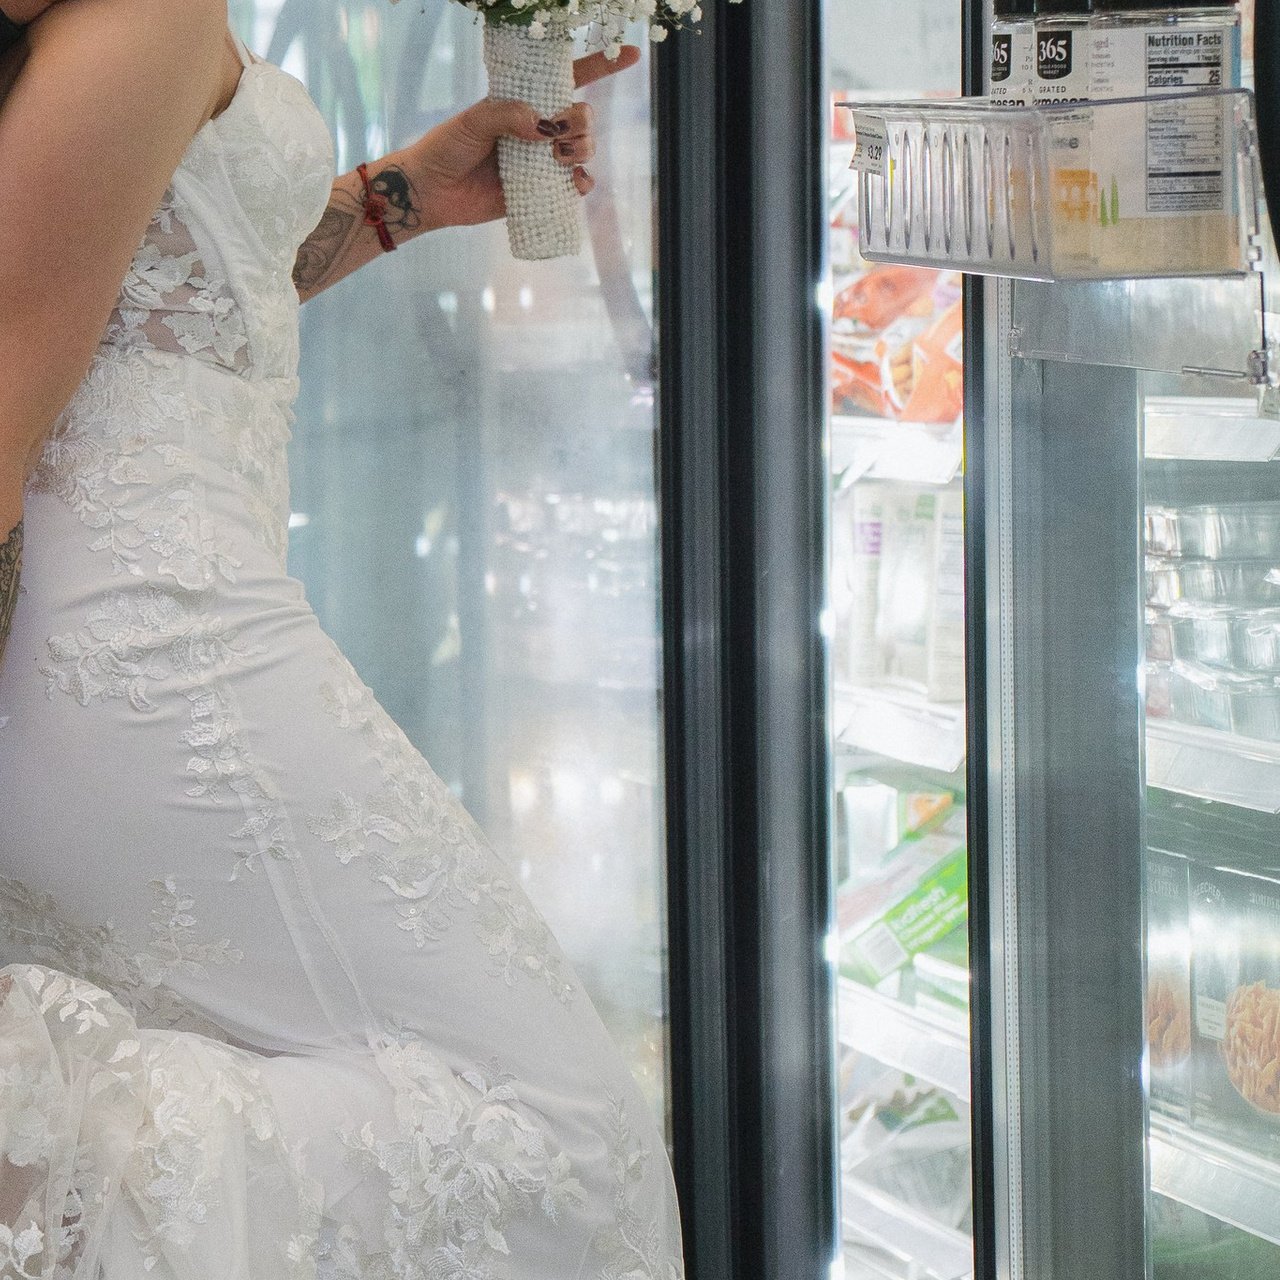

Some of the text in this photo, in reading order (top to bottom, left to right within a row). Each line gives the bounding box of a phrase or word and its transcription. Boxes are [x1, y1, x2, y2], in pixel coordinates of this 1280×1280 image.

[1148, 33, 1222, 47] Nutrition Facts
[992, 41, 1008, 64] 65
[1038, 37, 1068, 62] 365
[1148, 70, 1221, 85] Calories 25
[1039, 85, 1067, 93] GRATED
[868, 144, 883, 161] $3.29
